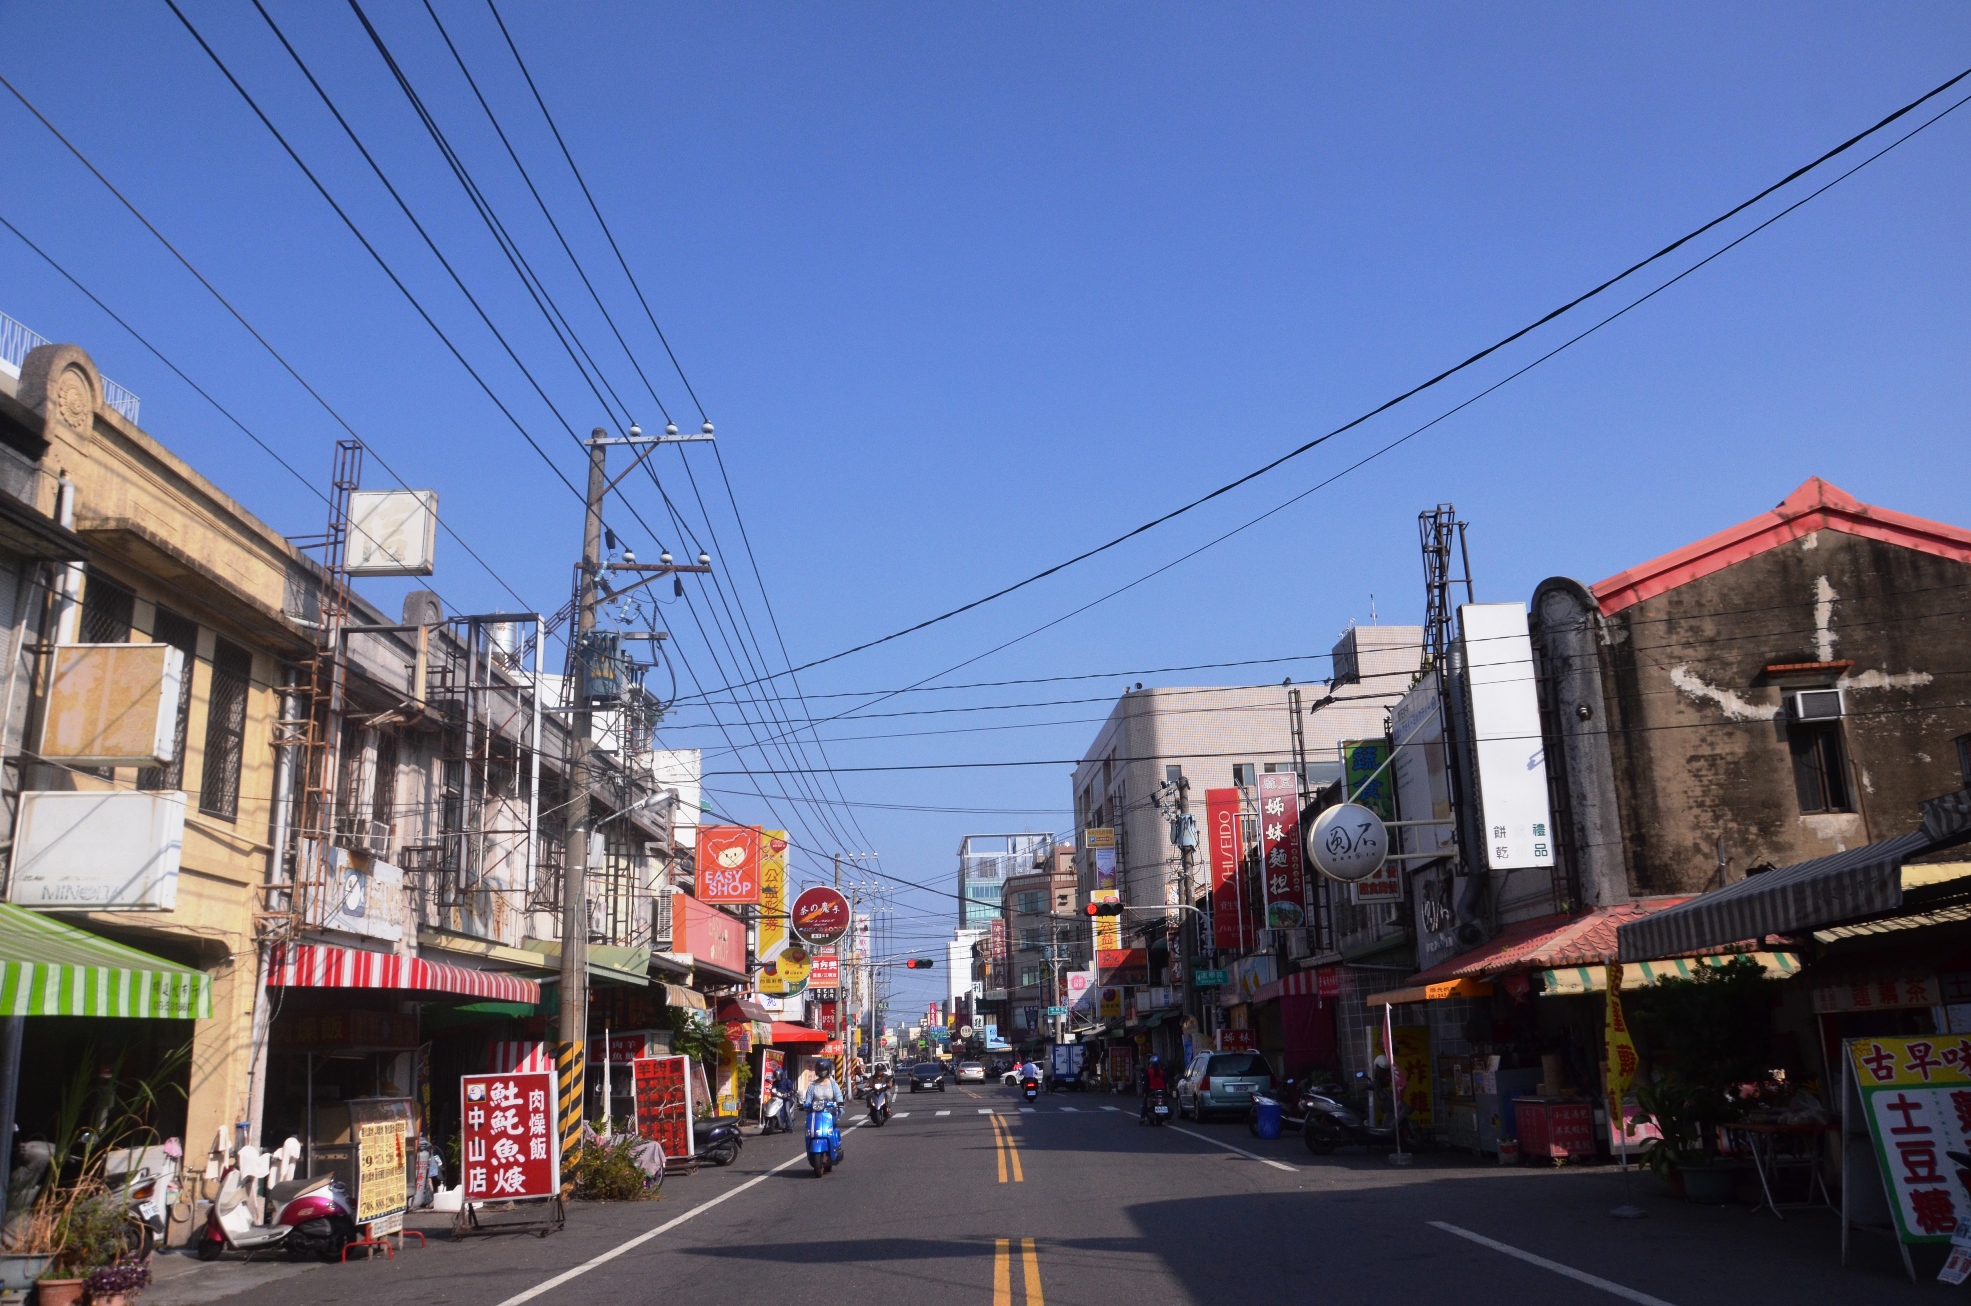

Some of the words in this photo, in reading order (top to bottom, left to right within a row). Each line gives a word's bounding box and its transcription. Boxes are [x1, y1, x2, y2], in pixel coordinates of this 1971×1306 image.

[1262, 776, 1294, 790] 麻豆
[1219, 811, 1237, 890] SHISEIDO
[1494, 825, 1509, 859] 餅乾
[1532, 823, 1548, 857] 禮品
[705, 870, 742, 884] EASY
[709, 881, 751, 896] SHOP
[765, 868, 779, 932] 公益彩券
[799, 901, 840, 916] 茶の魔手
[1862, 1039, 1971, 1083] 古早味
[528, 1088, 547, 1161] 肉燥飯
[468, 1106, 487, 1193] 中山店
[1886, 1092, 1959, 1235] 土豆糖
